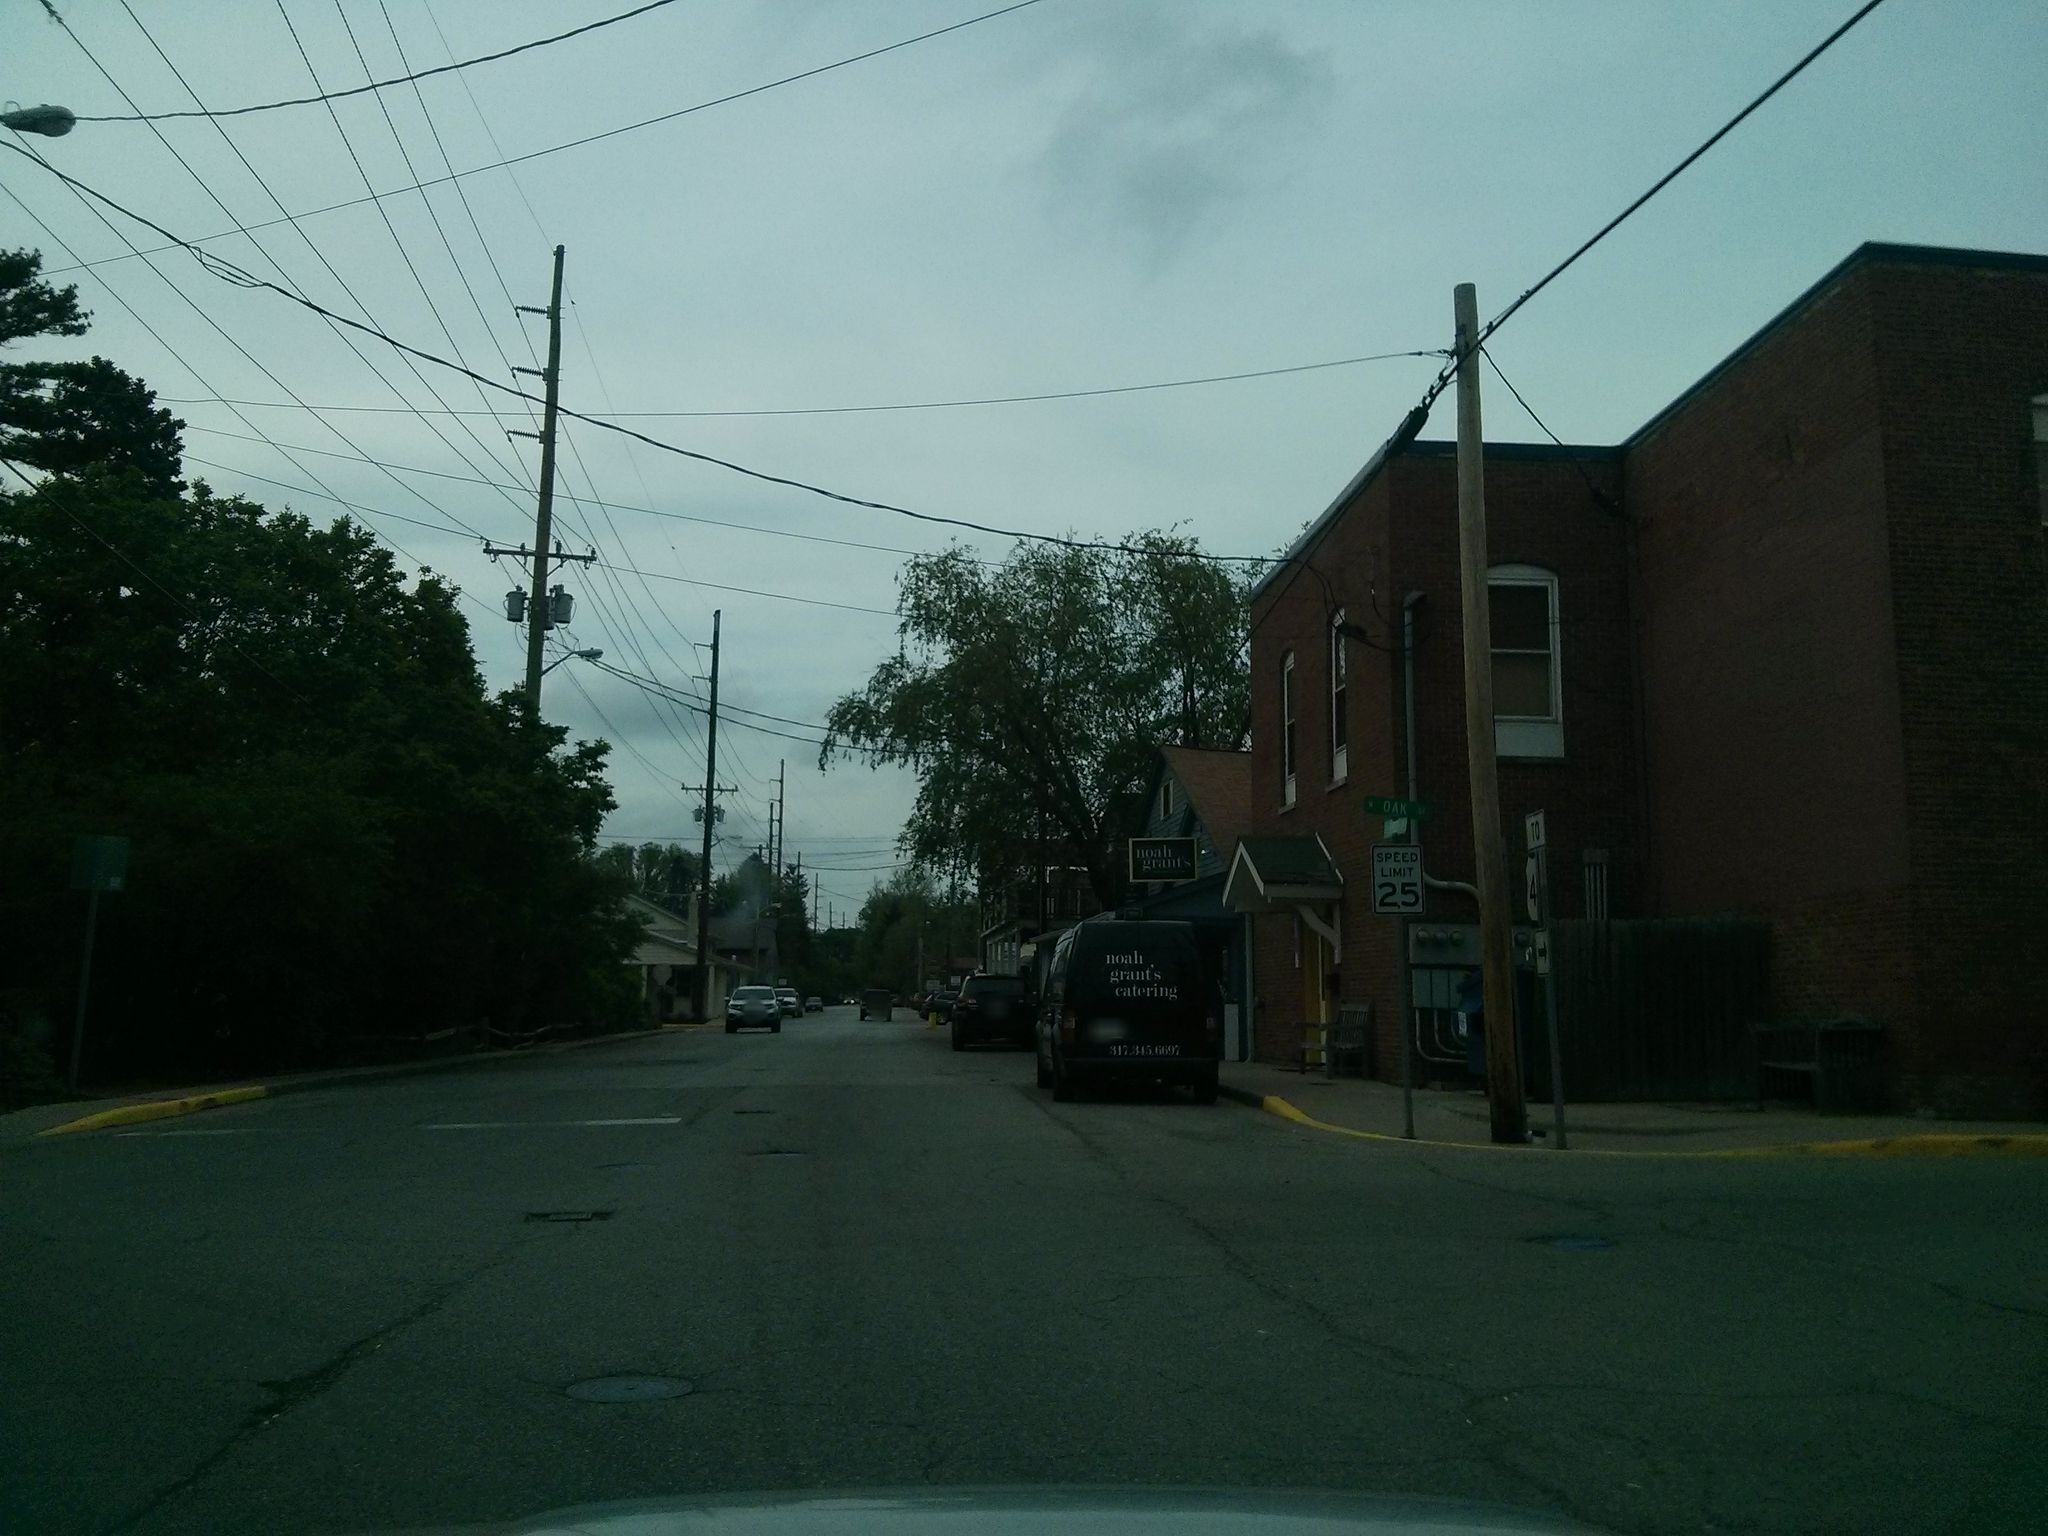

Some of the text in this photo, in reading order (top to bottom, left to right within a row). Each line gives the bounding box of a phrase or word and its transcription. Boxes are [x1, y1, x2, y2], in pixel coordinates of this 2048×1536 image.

[1383, 800, 1407, 815] OAK
[1530, 820, 1540, 842] TO
[1136, 844, 1173, 858] noah
[1376, 851, 1418, 863] SPEED
[1380, 867, 1414, 878] LIMIT
[1377, 882, 1420, 908] 25
[1529, 875, 1537, 906] 4
[1105, 950, 1144, 965] noah
[1109, 964, 1162, 984] grant's
[1114, 983, 1179, 1001] catering
